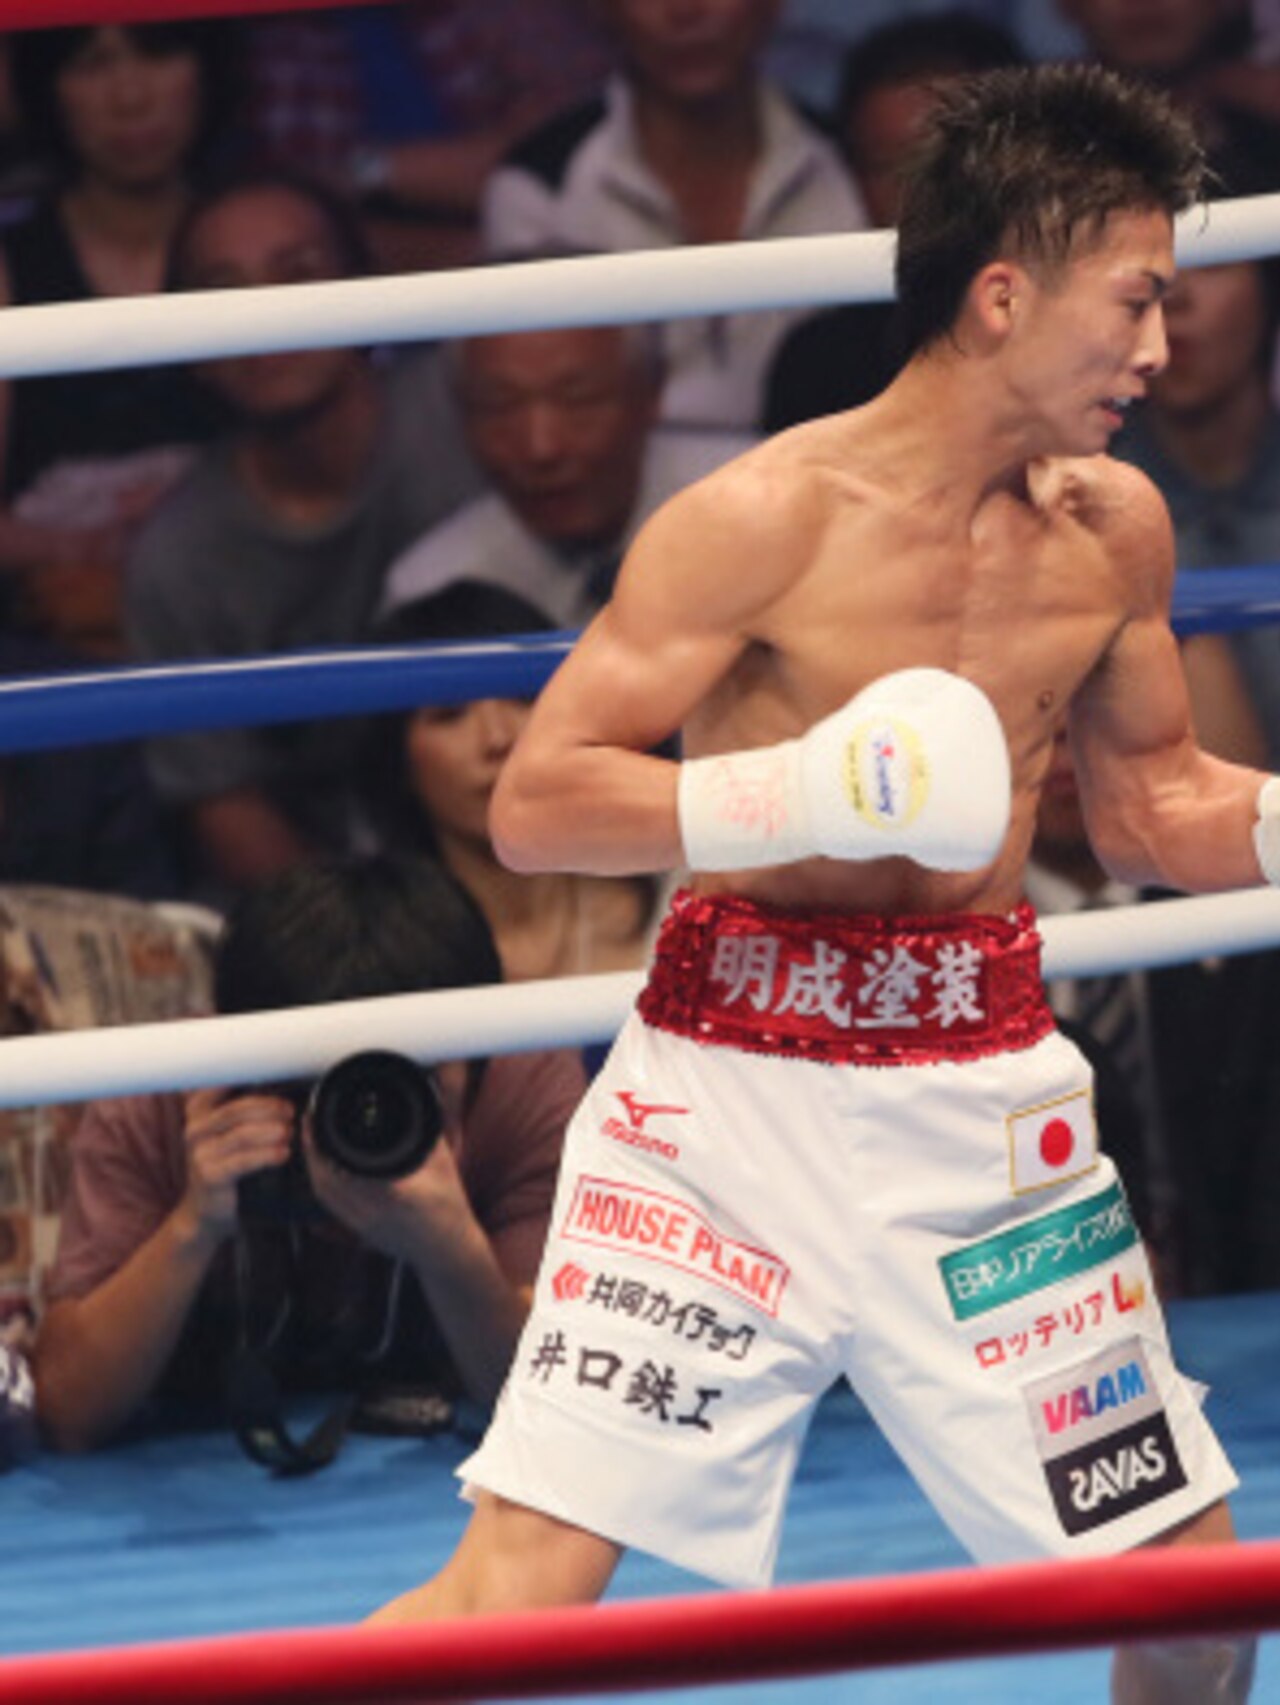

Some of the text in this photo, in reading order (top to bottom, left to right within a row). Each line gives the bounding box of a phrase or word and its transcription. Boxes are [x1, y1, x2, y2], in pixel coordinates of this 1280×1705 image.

[711, 935, 985, 1029] 明成塗装
[578, 1190, 778, 1300] HOUSE PLAN
[974, 1290, 1106, 1369] ロッテリア
[530, 1330, 723, 1434] 井口鉄工
[1042, 1360, 1147, 1435] VAAM
[1068, 1435, 1167, 1512] SAVAS
